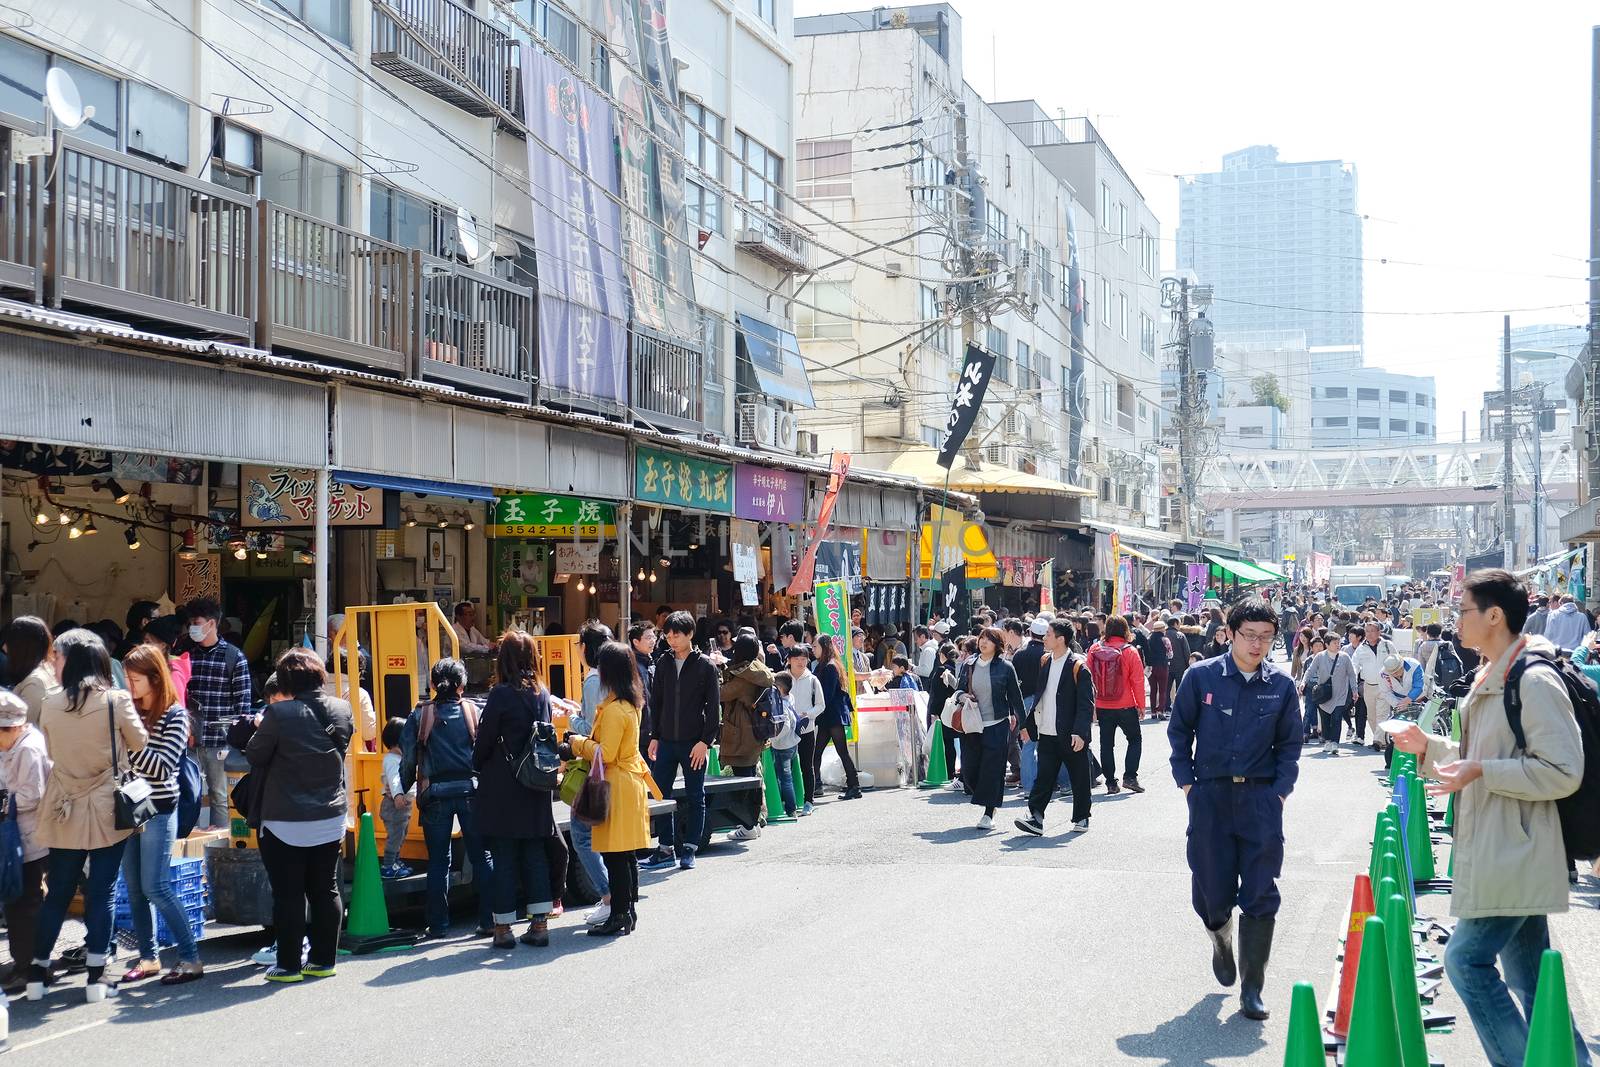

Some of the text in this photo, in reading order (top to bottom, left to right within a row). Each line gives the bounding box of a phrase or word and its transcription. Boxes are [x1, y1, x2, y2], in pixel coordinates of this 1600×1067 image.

[269, 472, 345, 499] フィッュ
[290, 493, 371, 520] マケット
[503, 498, 601, 523] 玉子焼
